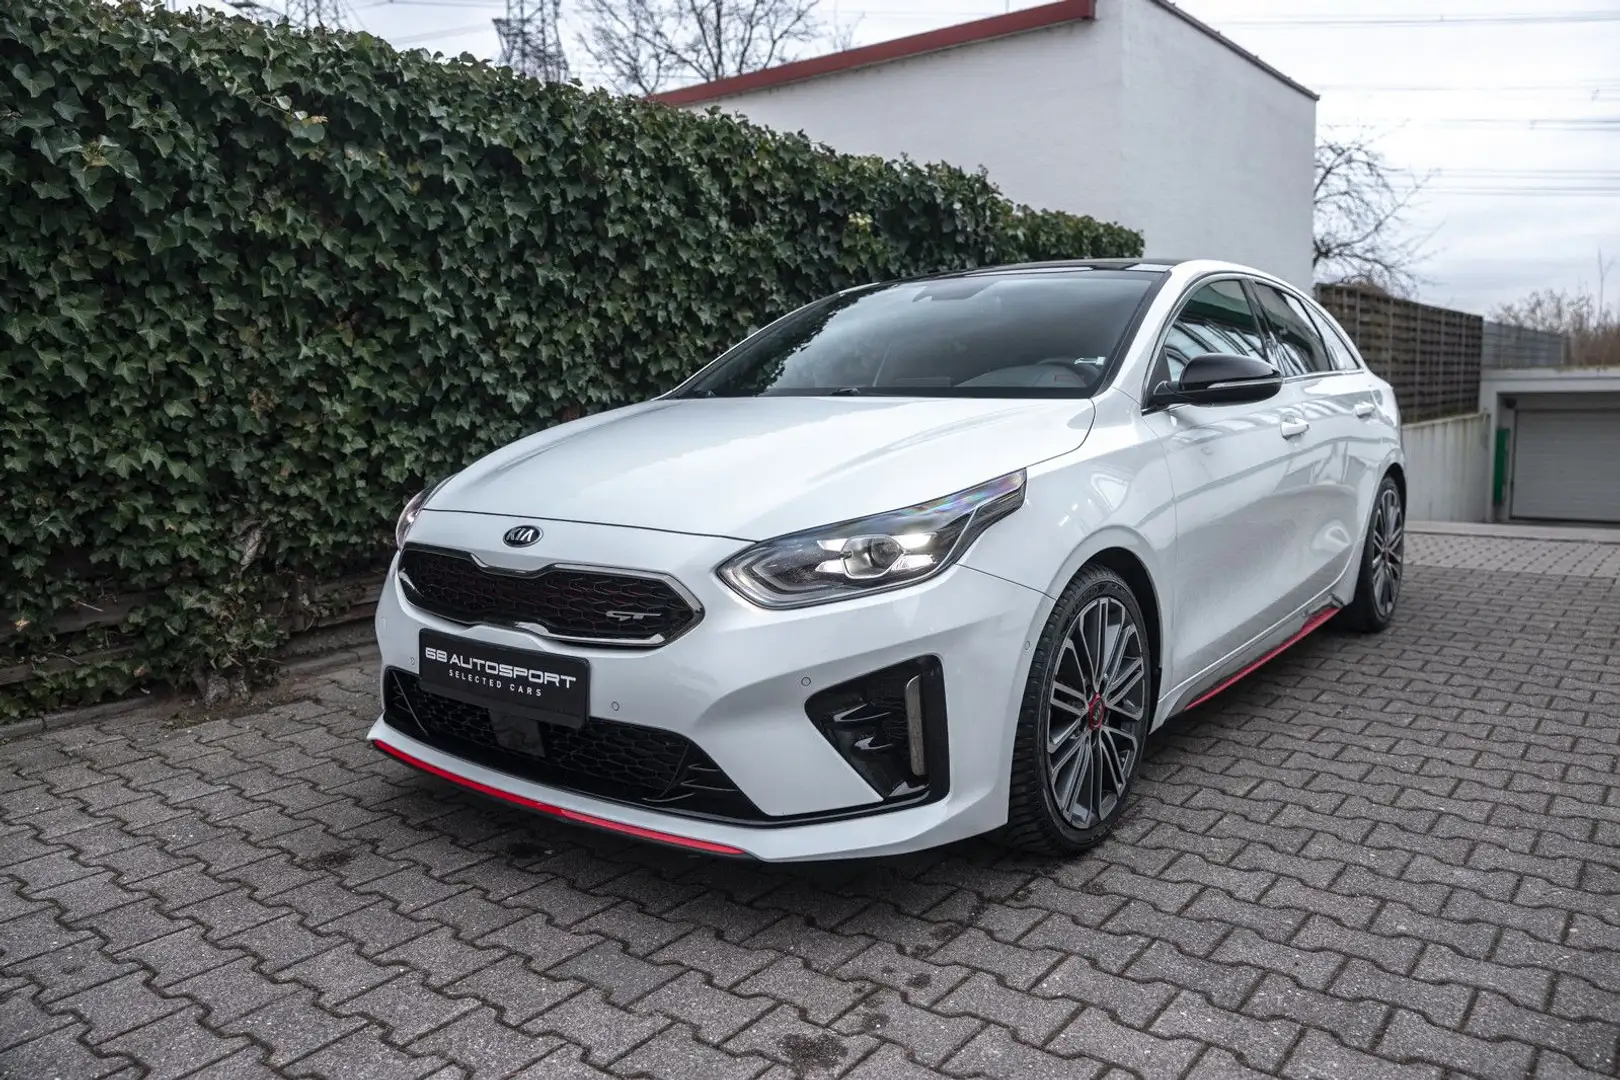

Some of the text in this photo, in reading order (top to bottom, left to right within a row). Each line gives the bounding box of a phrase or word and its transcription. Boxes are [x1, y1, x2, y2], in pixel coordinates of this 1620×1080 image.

[425, 646, 577, 689] 68 AUTOSPORT
[449, 669, 542, 697] SELECTED CARS
